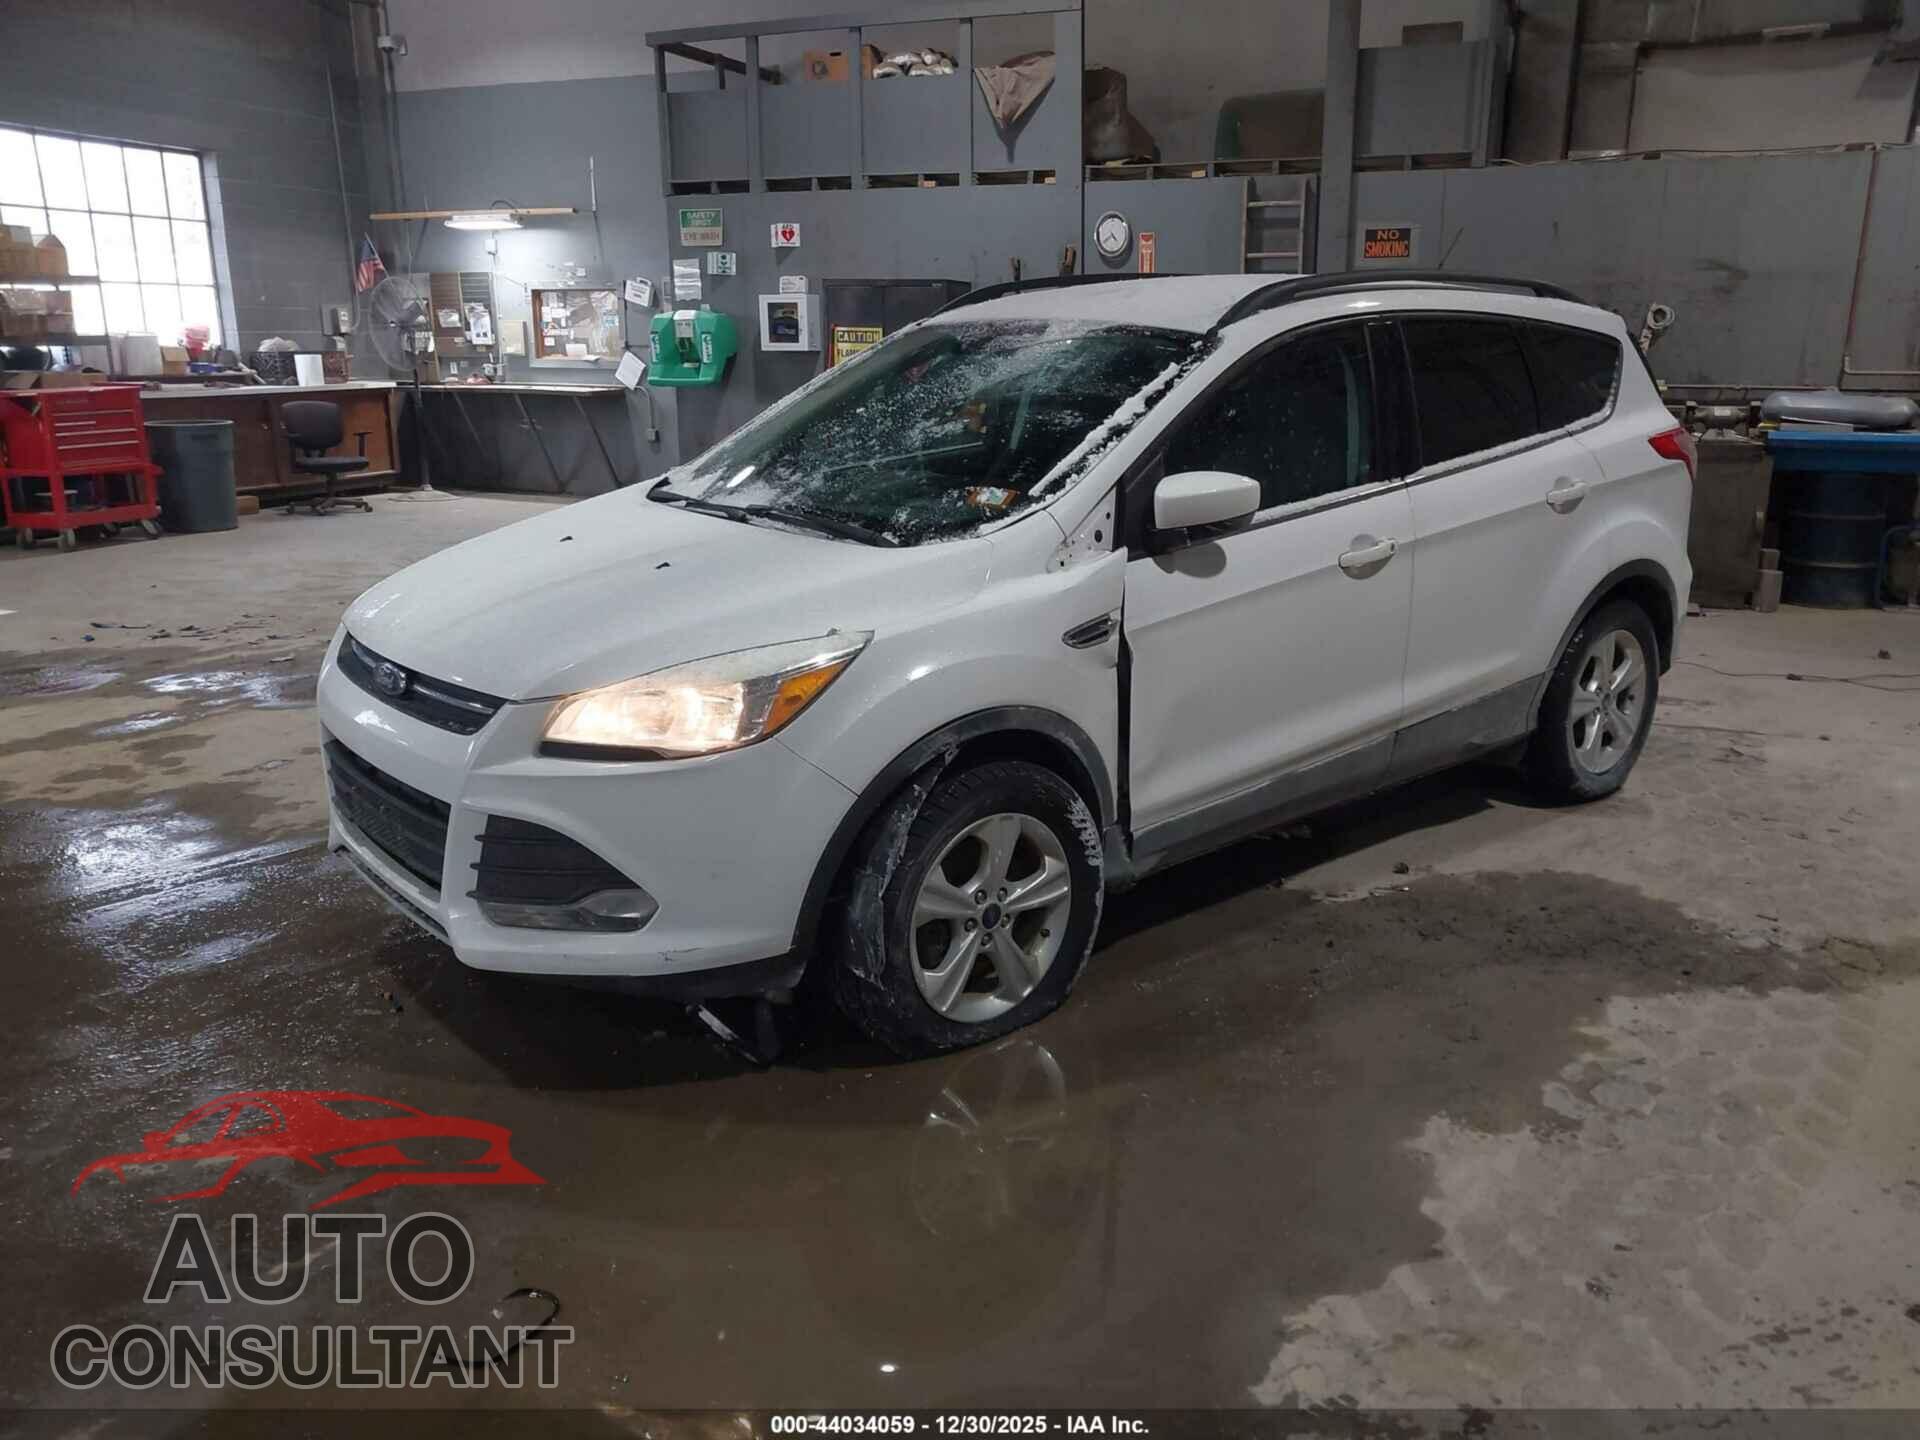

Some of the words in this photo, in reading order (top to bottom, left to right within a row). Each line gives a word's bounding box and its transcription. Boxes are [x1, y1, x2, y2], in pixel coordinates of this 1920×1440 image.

[1377, 230, 1400, 240] NO
[1365, 240, 1409, 257] SMOKING
[837, 331, 881, 343] CAUTION
